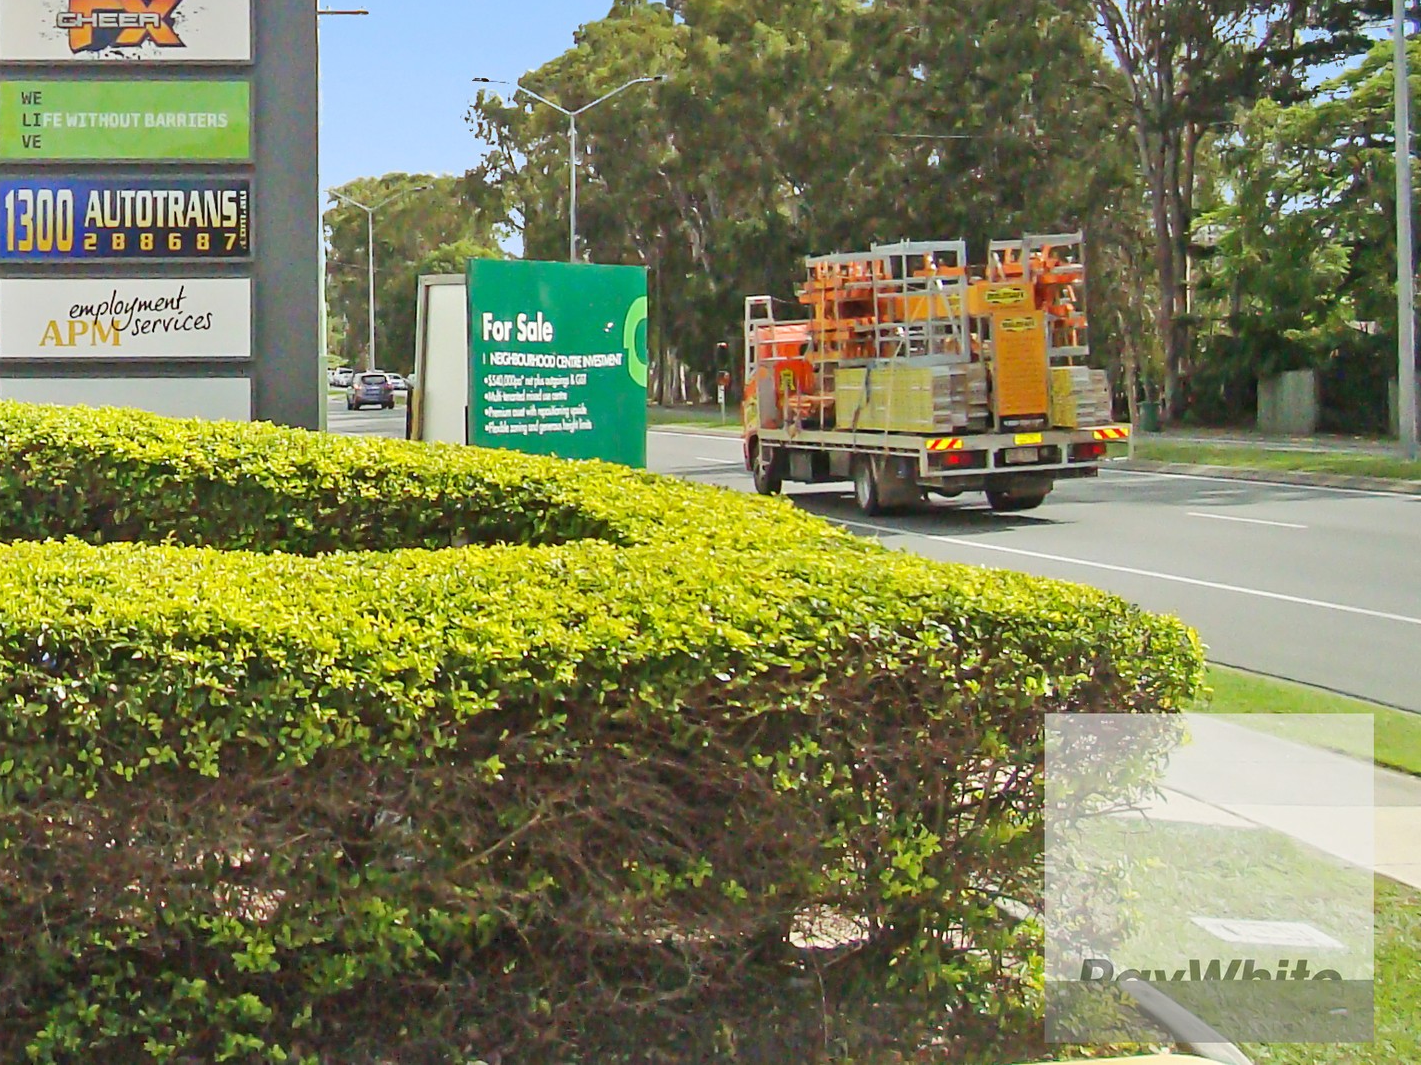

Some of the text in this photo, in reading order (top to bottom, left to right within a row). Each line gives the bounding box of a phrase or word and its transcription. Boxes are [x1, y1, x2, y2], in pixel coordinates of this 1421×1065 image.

[21, 91, 42, 106] WE
[66, 112, 141, 128] WITHOUT
[144, 112, 228, 128] BARRIERS
[22, 134, 42, 149] VE
[4, 188, 238, 252] 1300 AUTOTRANS
[69, 285, 187, 331] employment
[39, 319, 122, 347] APM
[131, 311, 213, 336] services
[482, 311, 553, 342] For Sale
